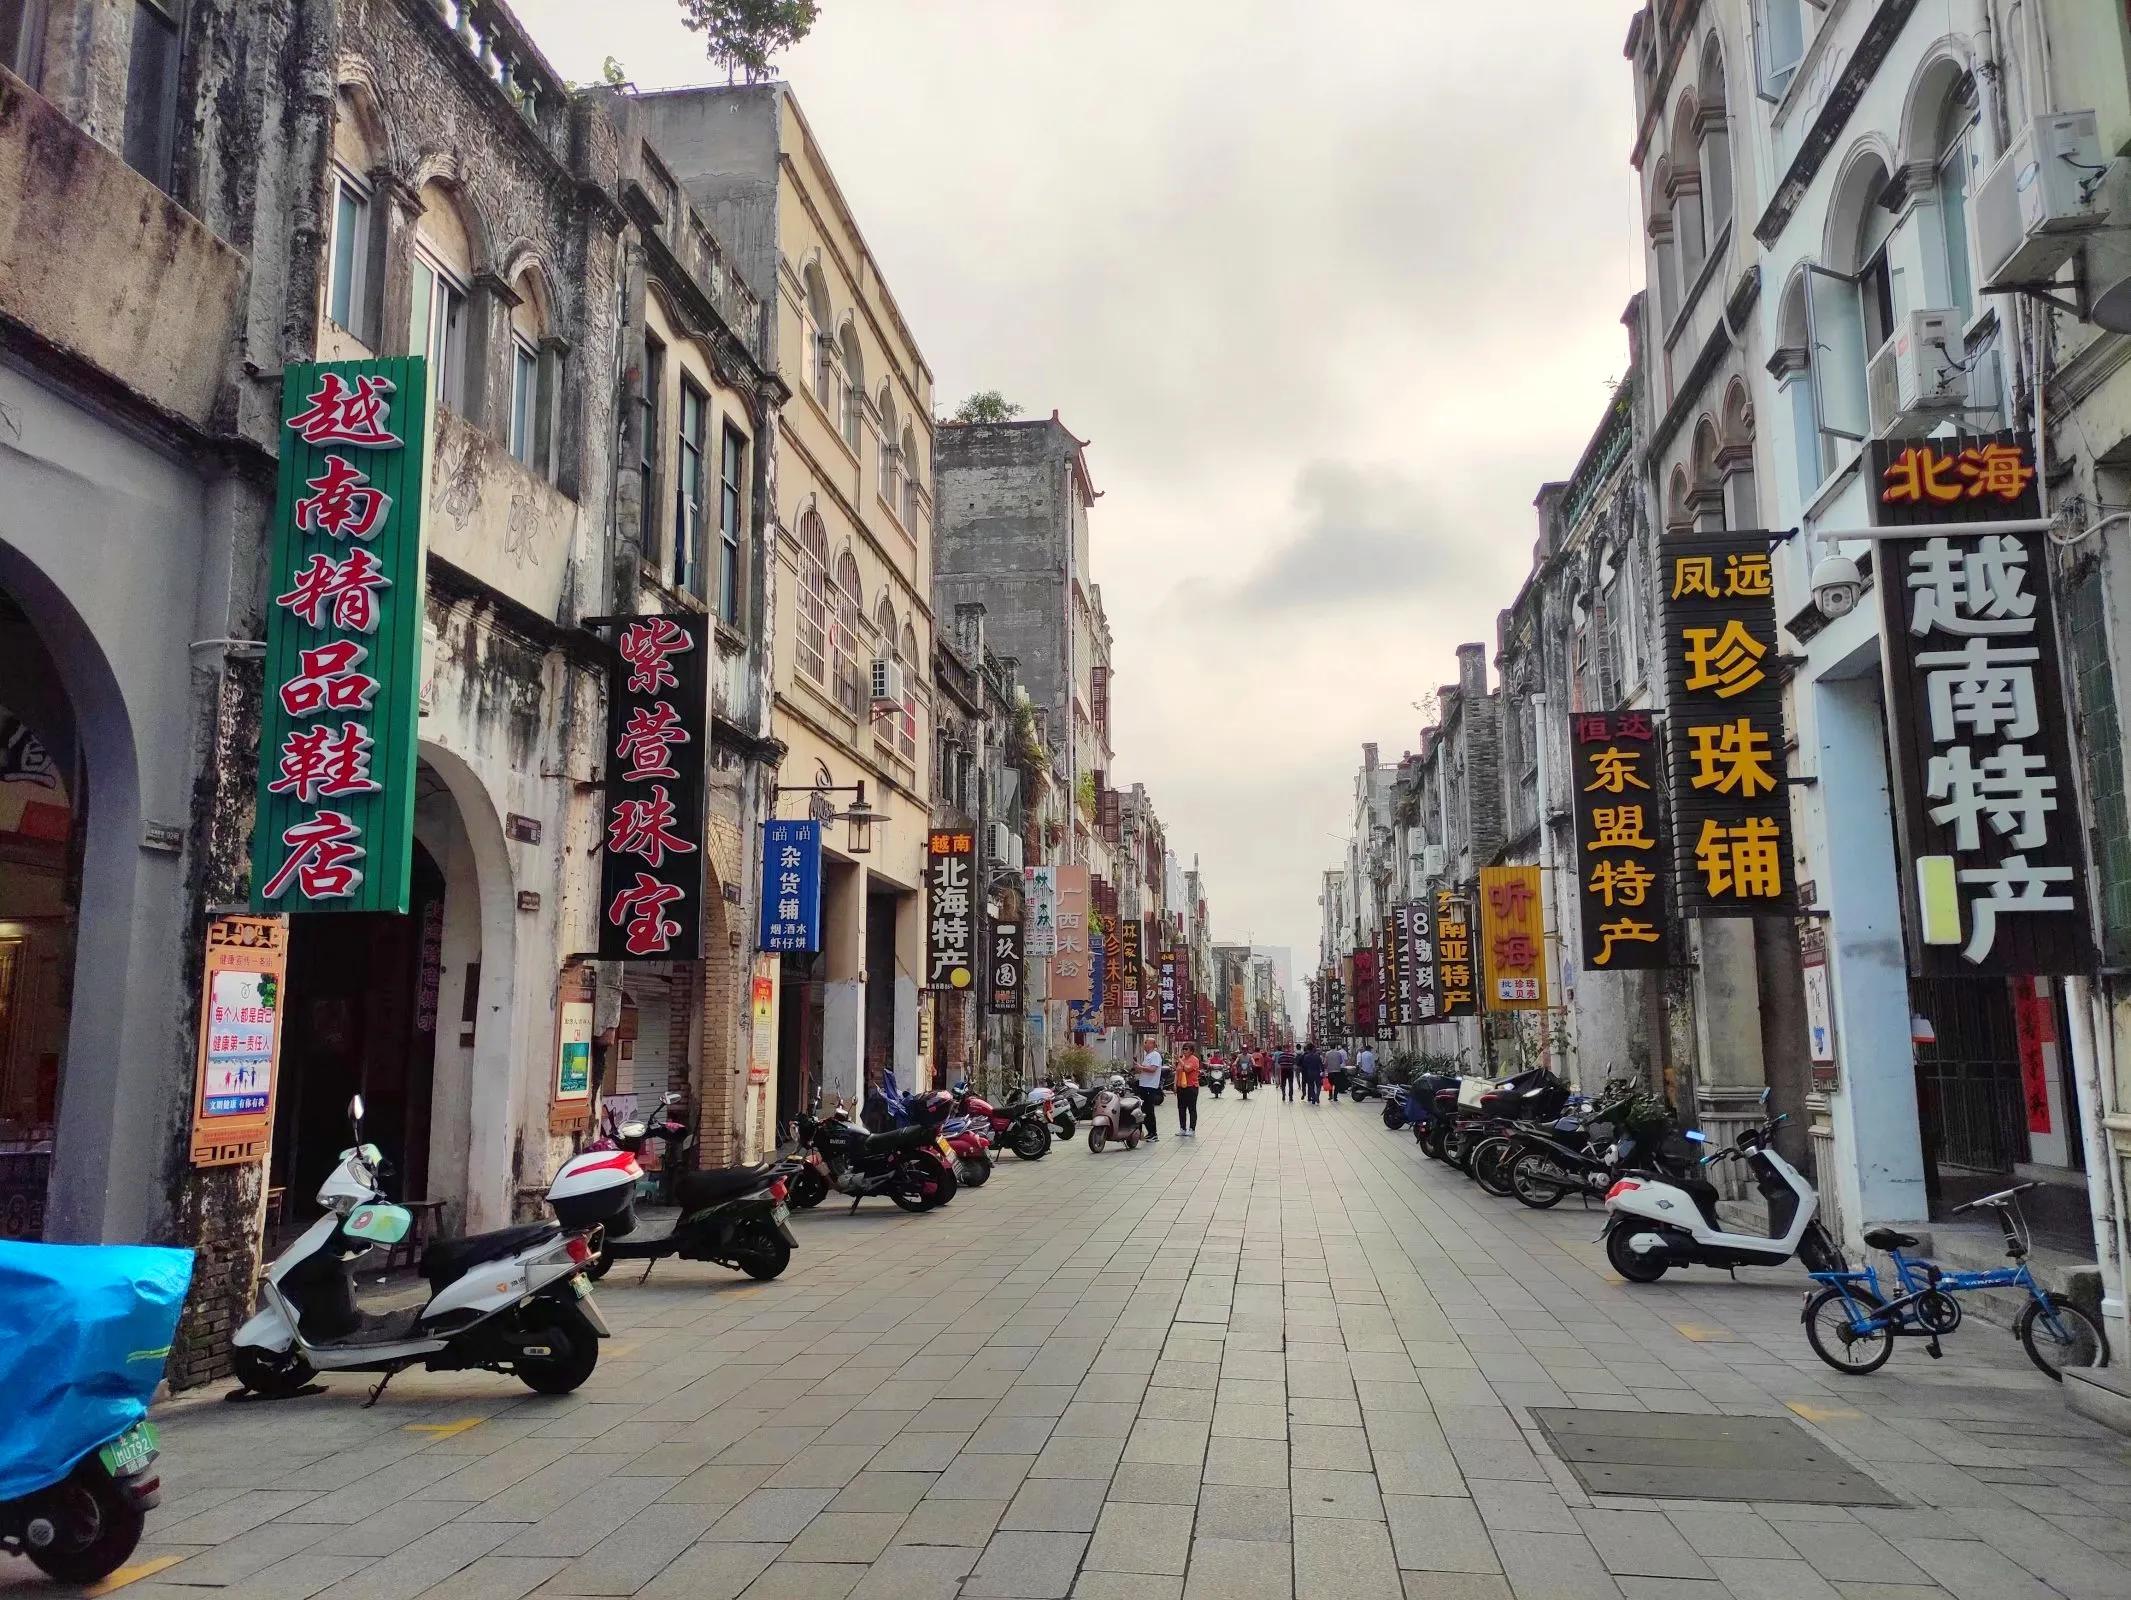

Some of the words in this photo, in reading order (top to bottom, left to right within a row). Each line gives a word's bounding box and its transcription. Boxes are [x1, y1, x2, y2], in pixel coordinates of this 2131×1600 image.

[1882, 443, 2036, 505] 北海
[1671, 552, 1772, 600] 凤远
[262, 370, 406, 902] 越南精品鞋店
[1578, 713, 1654, 742] 恒达
[1906, 534, 2075, 965] 越南特产
[608, 615, 698, 956] 紫萱珠宝
[1682, 619, 1782, 901] 珍珠铺
[931, 835, 971, 854] 越南
[1582, 746, 1661, 966] 东盟特产
[778, 846, 801, 920] 杂货铺
[769, 923, 808, 936] 烟酒水
[769, 937, 807, 950] 虾仔饼
[931, 857, 969, 981] 北海特产
[1056, 888, 1083, 978] 广西米粉
[1488, 879, 1538, 972] 听海
[1162, 963, 1175, 1014] 平价特产
[1514, 979, 1536, 988] 珍珠
[215, 1006, 273, 1024] 每个人都是自己
[212, 1034, 271, 1053] 健康第一责任人
[209, 1097, 238, 1111] 文明健康
[238, 1095, 265, 1109] 有你有我
[116, 1438, 151, 1464] MU792
